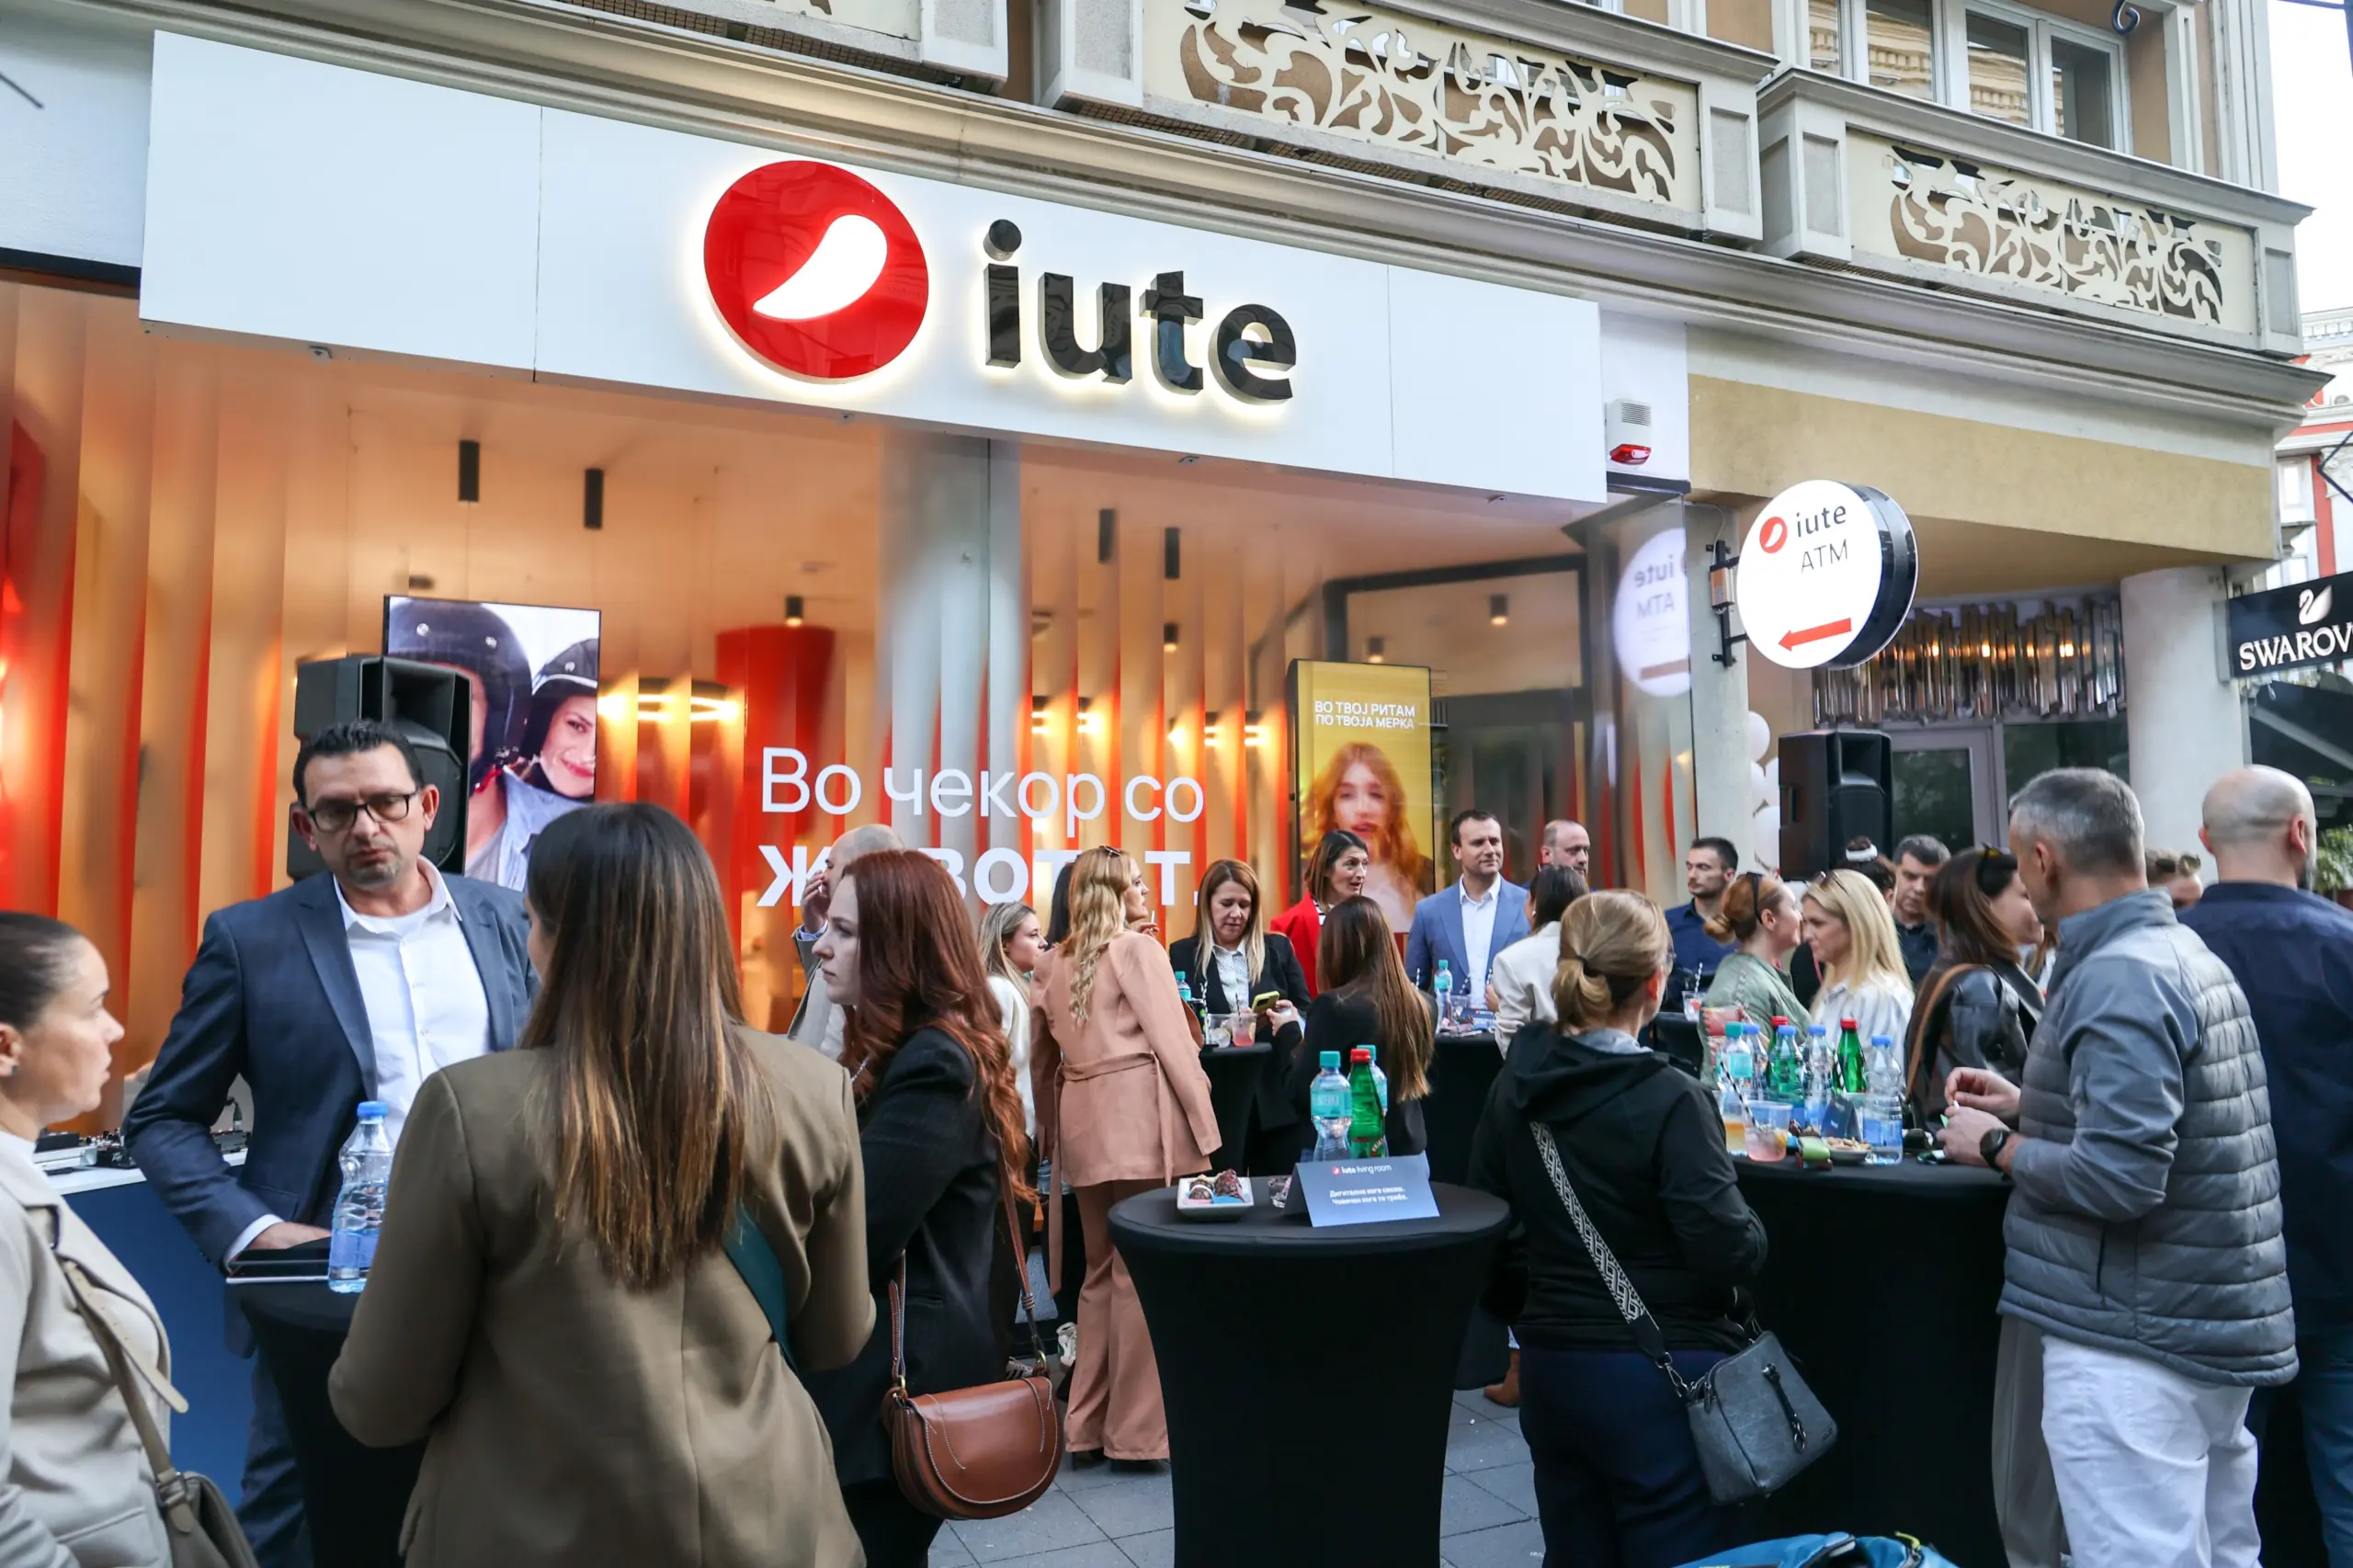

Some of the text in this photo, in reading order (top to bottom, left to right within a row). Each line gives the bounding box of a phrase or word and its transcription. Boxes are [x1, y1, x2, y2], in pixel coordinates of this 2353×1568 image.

[983, 219, 1297, 406] iute
[1795, 505, 1847, 538] iute
[1800, 539, 1849, 574] ATM
[1314, 700, 1415, 717] ВО ТВОЈ РИТАМ
[1315, 714, 1415, 730] ПО ТВОЈА МЕРКА
[761, 746, 1205, 838] Во чекор со
